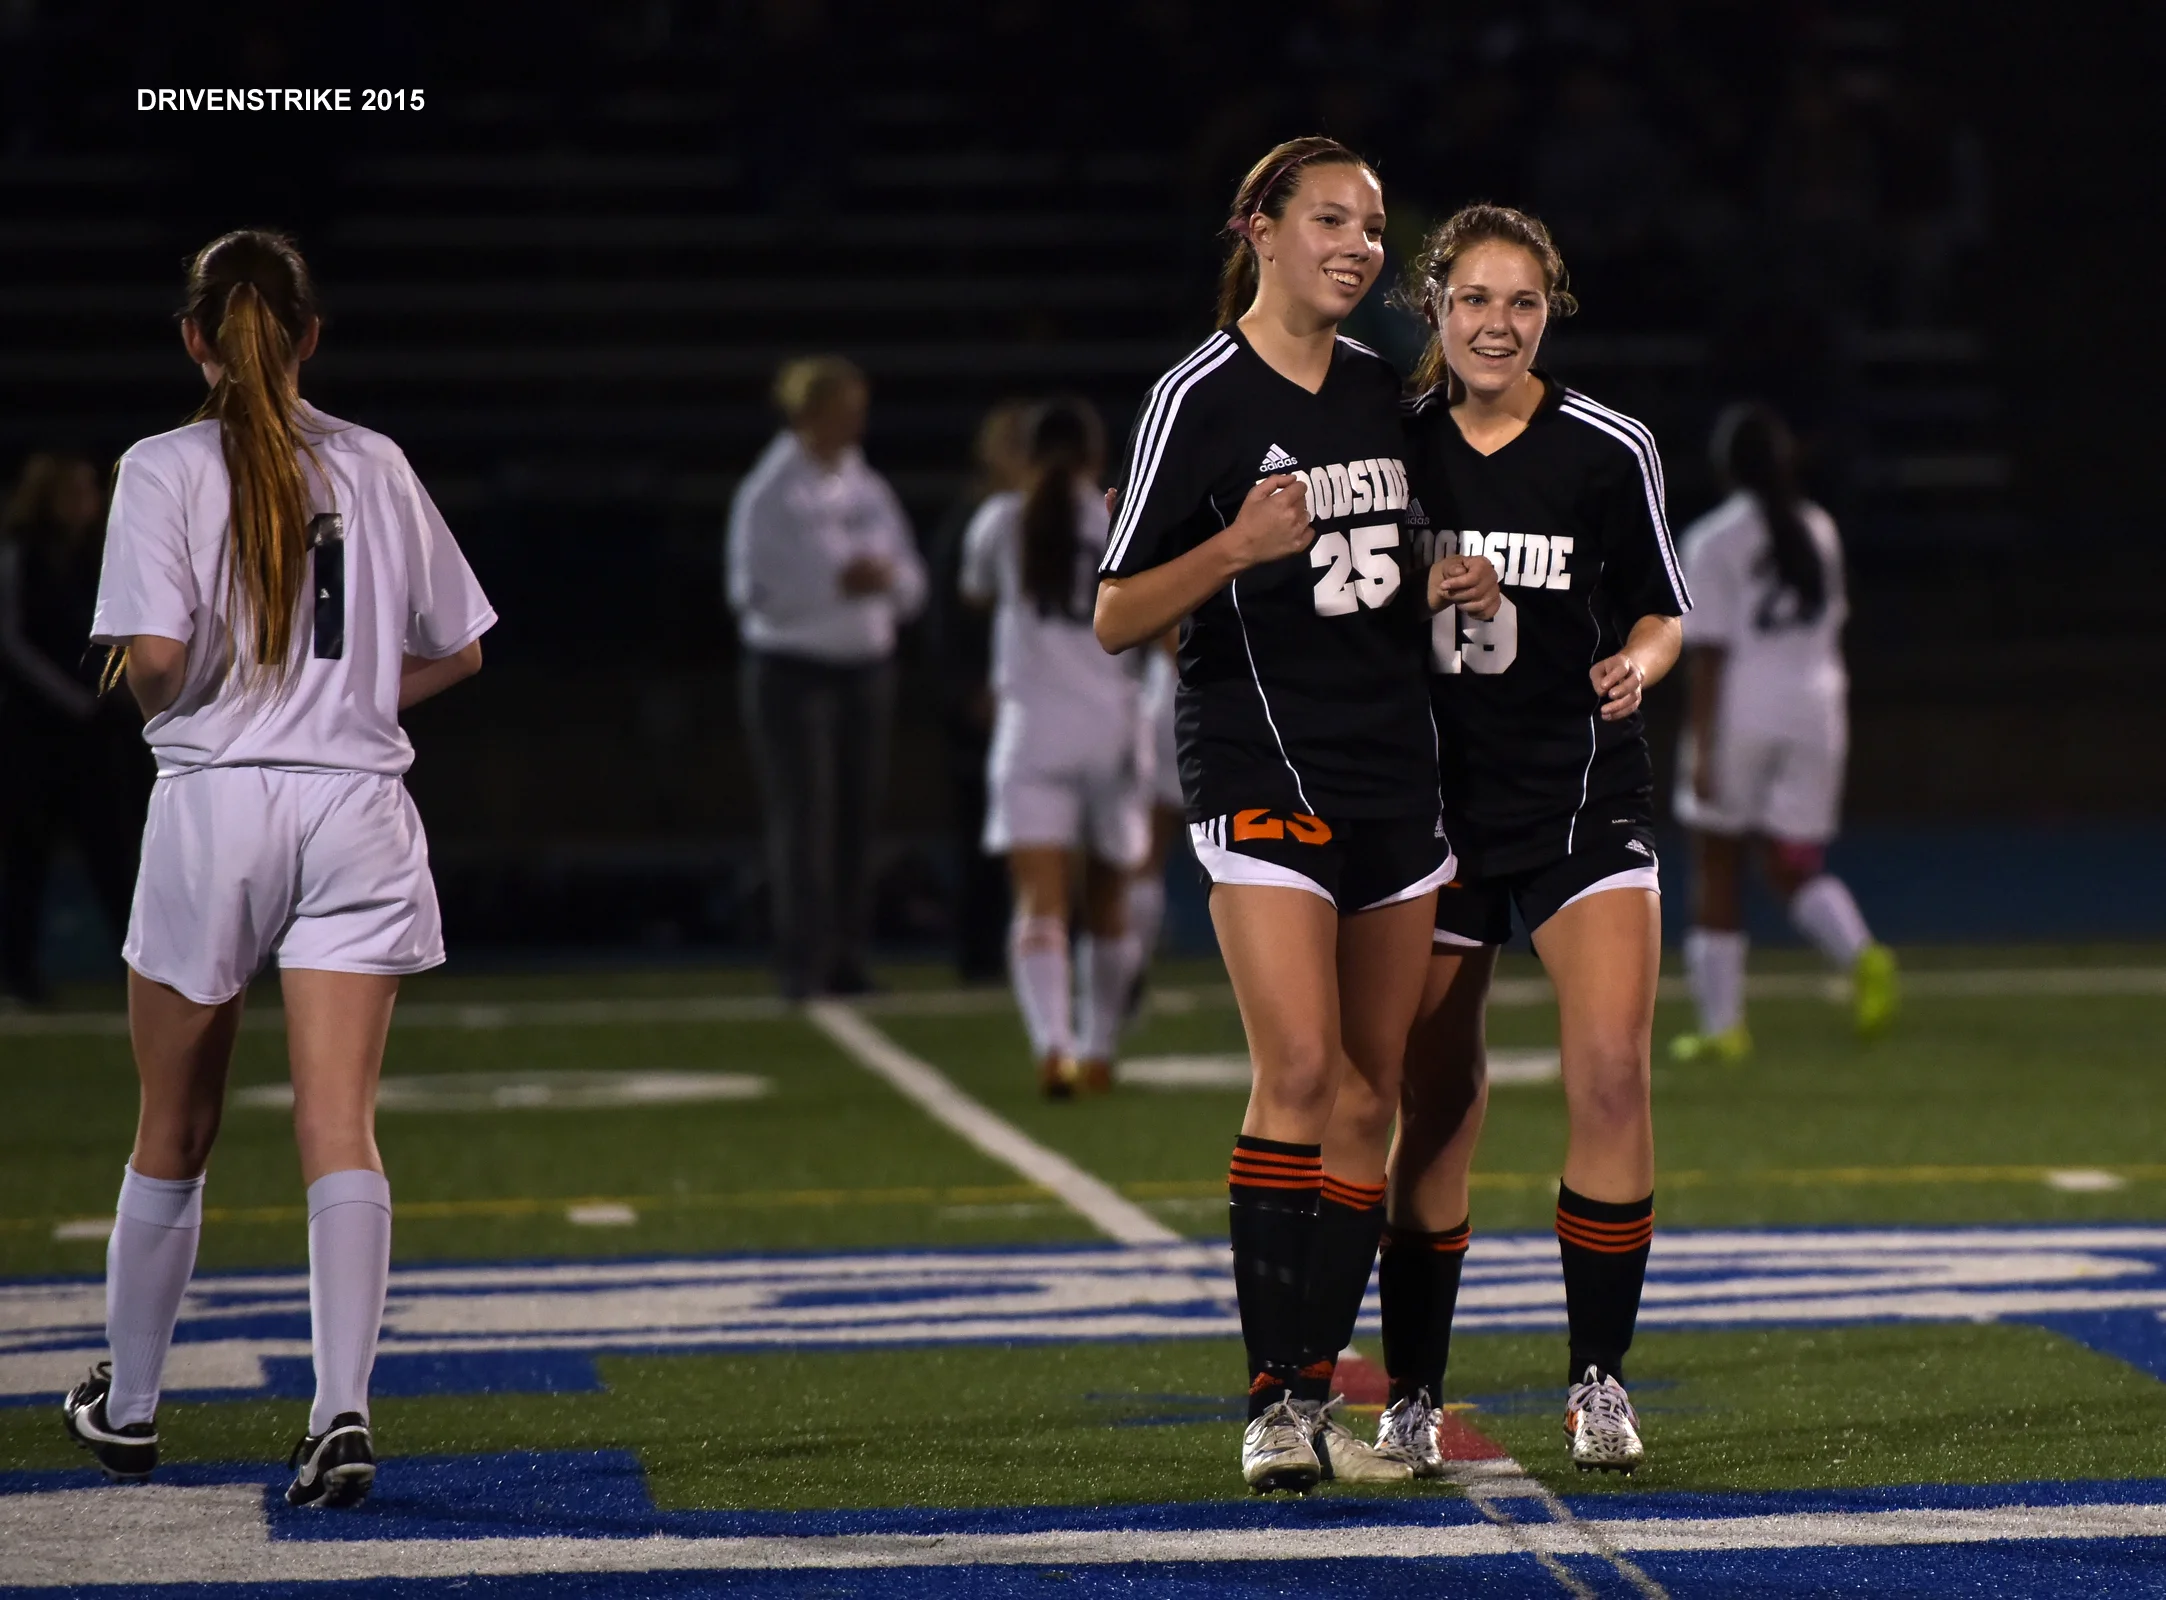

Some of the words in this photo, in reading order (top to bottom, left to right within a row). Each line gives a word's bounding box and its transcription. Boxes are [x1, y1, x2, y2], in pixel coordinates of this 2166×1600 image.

[1256, 458, 1410, 522] OODSIDE
[1259, 456, 1298, 472] adidas
[1310, 523, 1400, 617] 25
